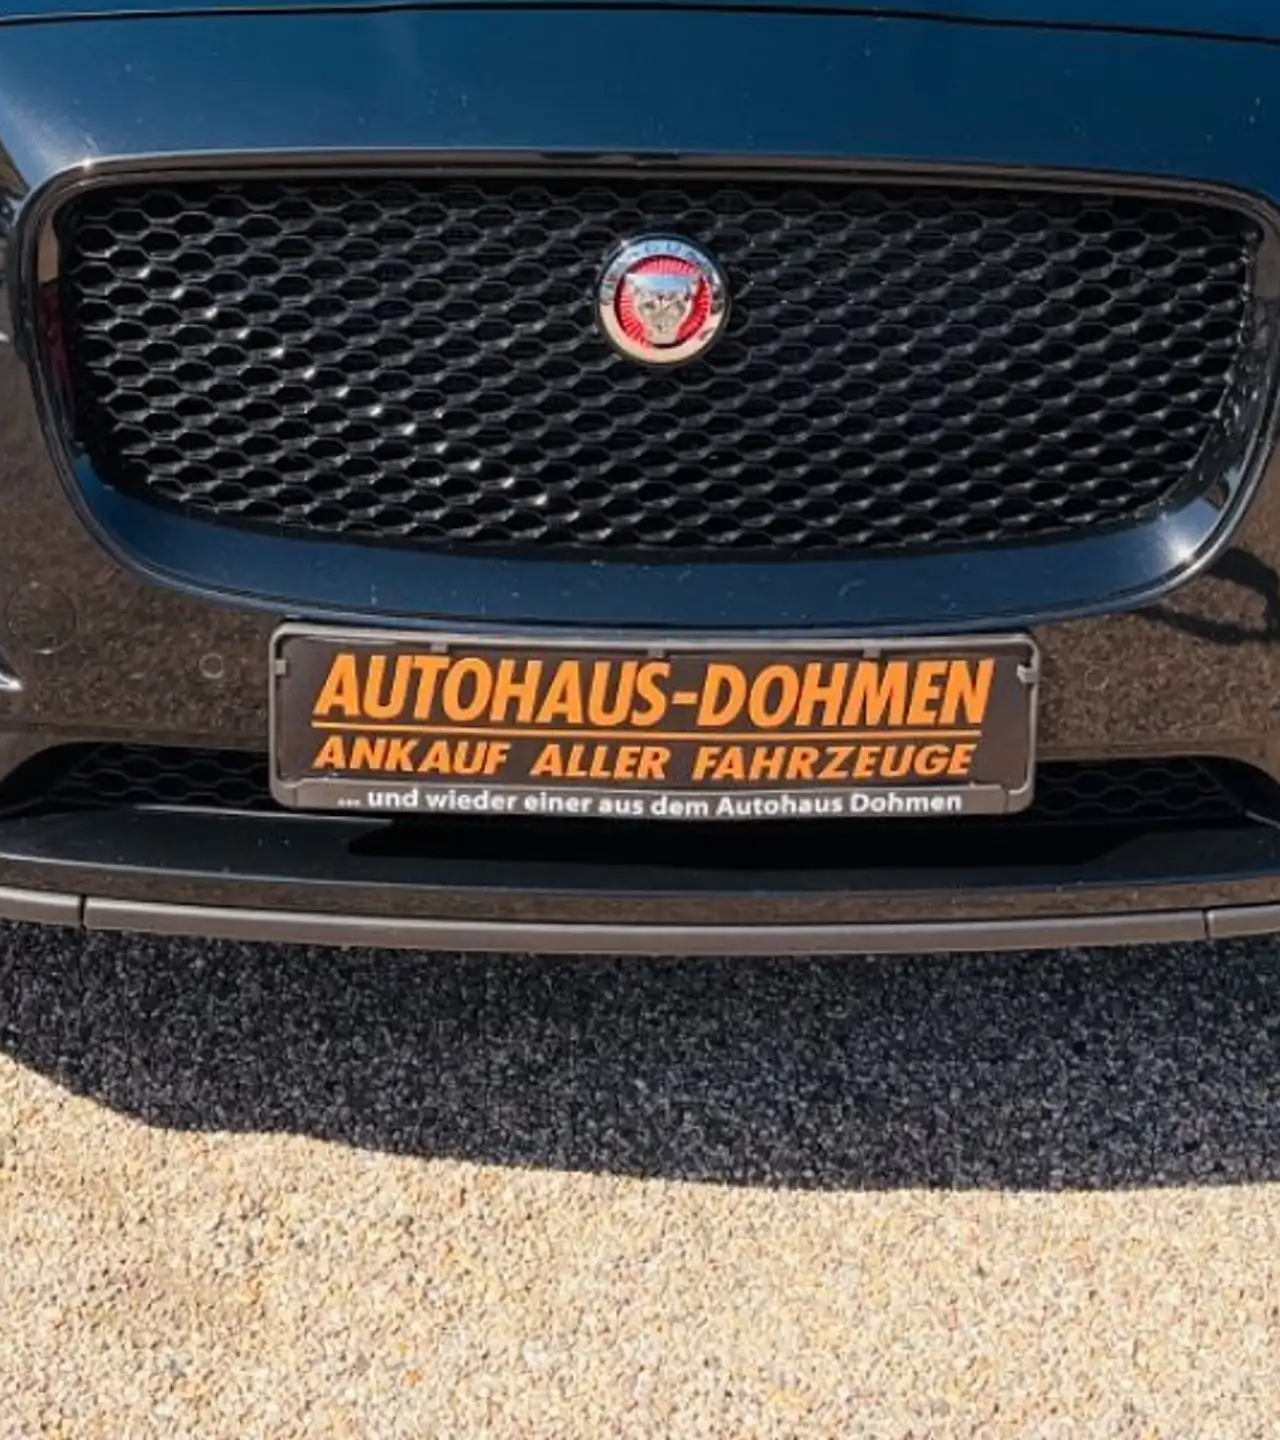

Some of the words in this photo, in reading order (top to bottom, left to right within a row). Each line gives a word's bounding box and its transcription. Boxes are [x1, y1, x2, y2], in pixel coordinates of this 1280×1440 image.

[313, 653, 995, 729] AUTOHAUS-DOHMEN
[312, 734, 511, 775] ANKAUF
[529, 742, 672, 780] ALLER
[691, 743, 978, 781] FAHRZEUGE
[368, 789, 418, 809] und
[425, 789, 517, 812] wieder
[524, 790, 594, 813] einer
[598, 798, 644, 815] aus
[650, 794, 708, 817] dem
[714, 793, 844, 817] Autohaus
[849, 791, 963, 813] Dohmen
